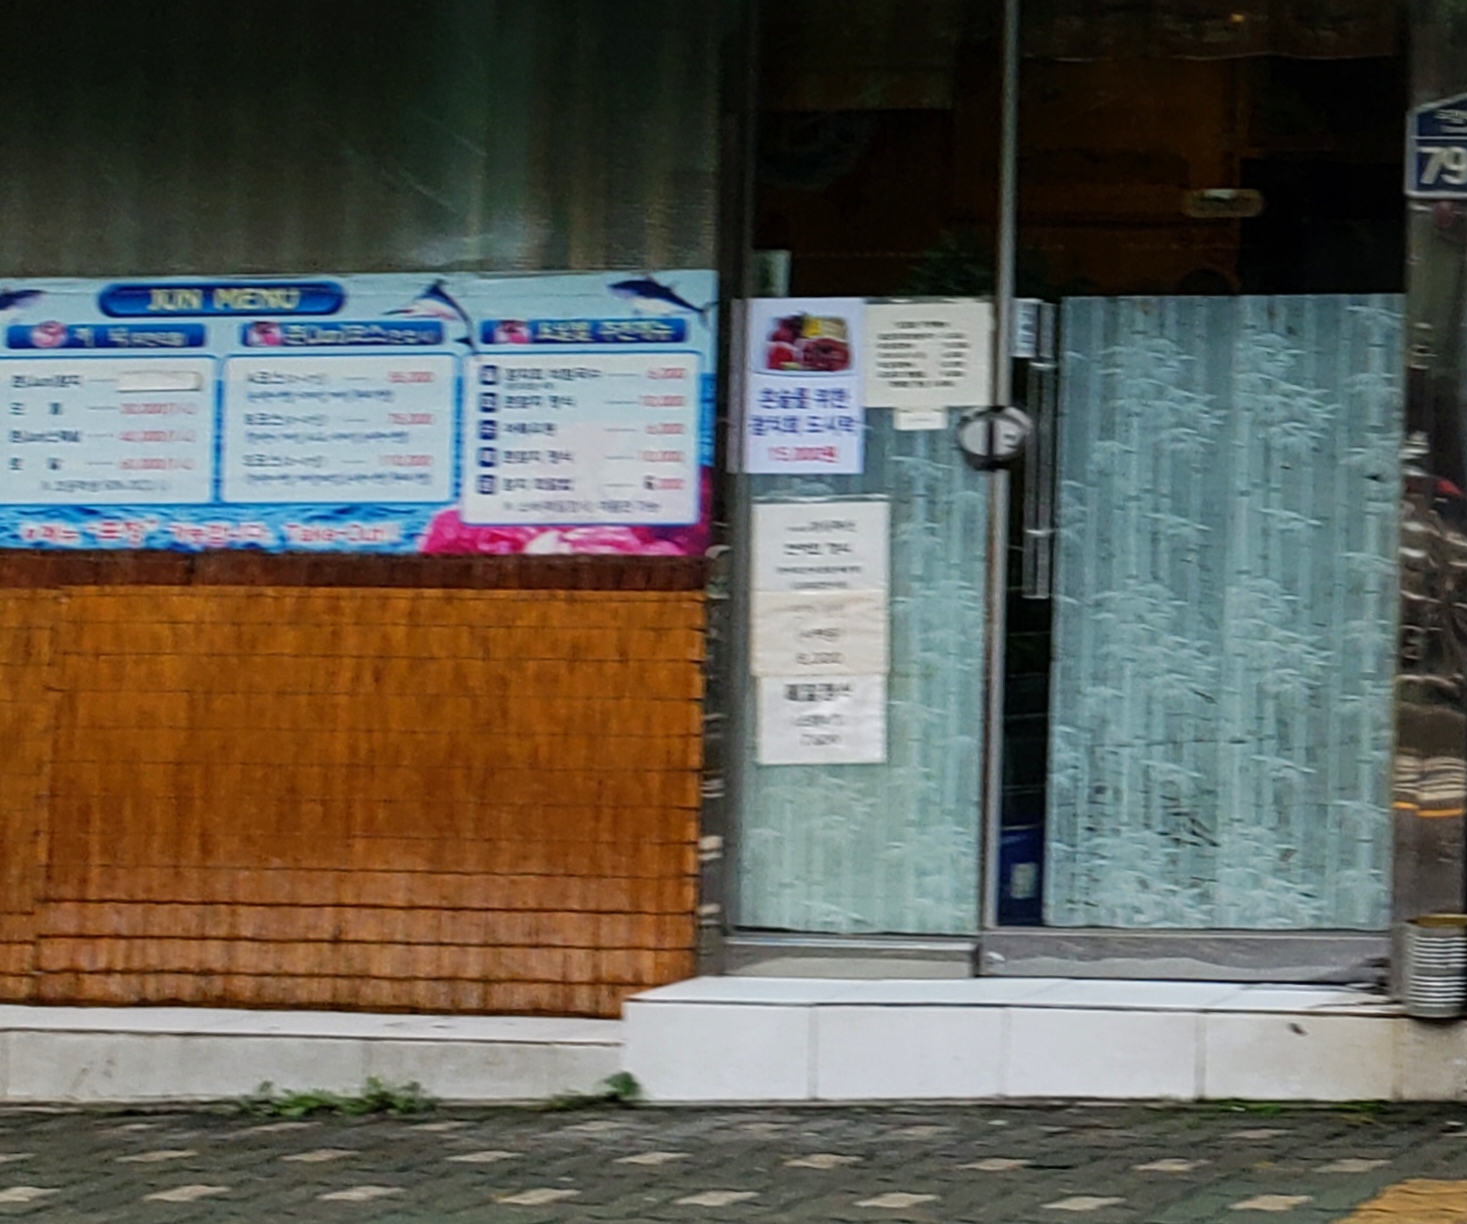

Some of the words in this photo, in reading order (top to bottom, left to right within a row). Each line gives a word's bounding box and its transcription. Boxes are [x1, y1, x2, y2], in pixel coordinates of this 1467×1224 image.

[148, 287, 203, 309] JUN
[212, 287, 301, 309] MENU
[812, 388, 851, 409] 위한
